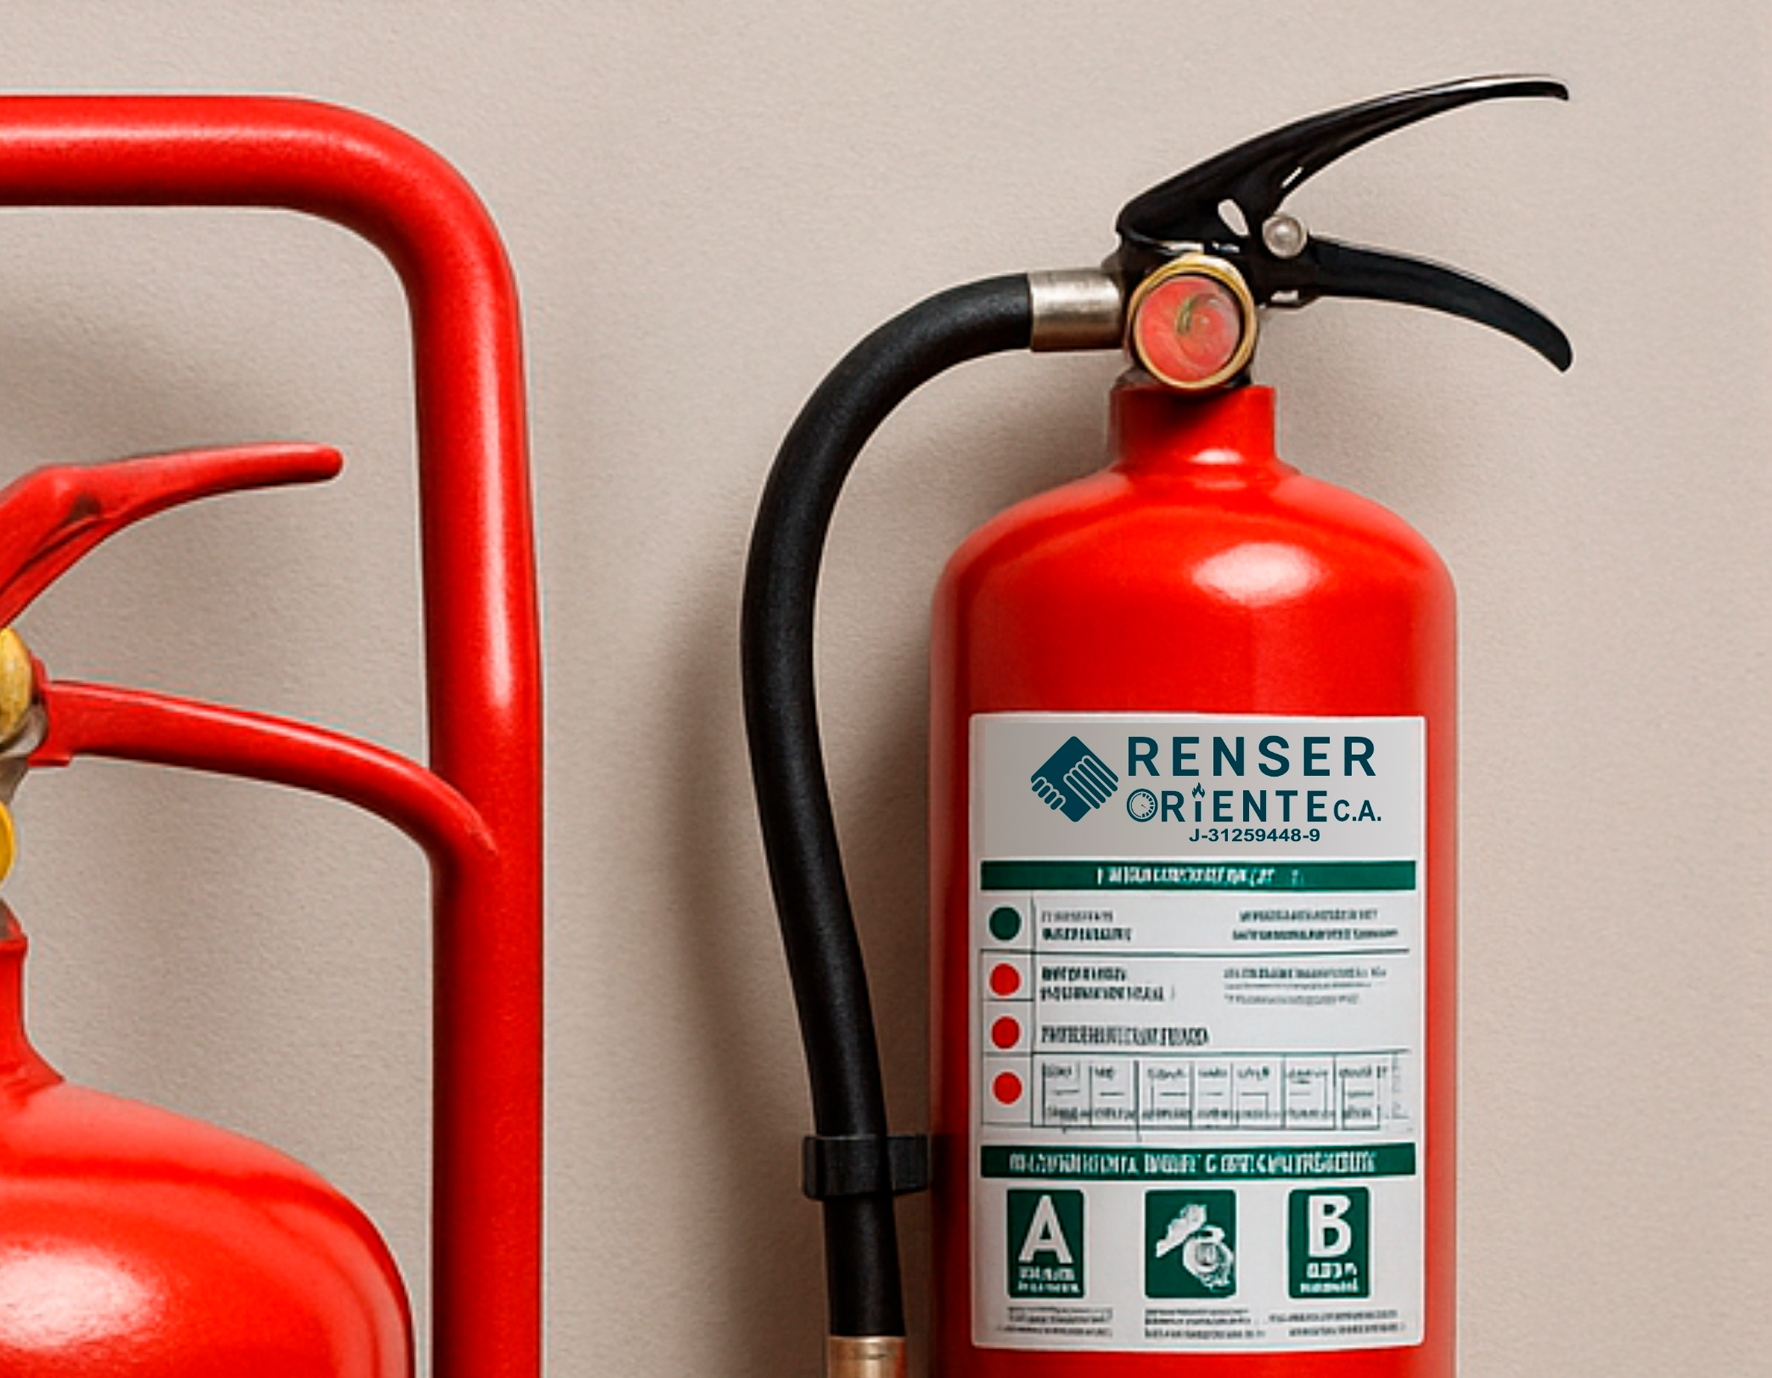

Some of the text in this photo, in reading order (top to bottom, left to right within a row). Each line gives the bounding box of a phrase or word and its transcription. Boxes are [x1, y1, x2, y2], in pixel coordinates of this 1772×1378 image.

[1128, 735, 1377, 778] RENSER
[1189, 828, 1321, 843] J-31259448-9
[1018, 1195, 1074, 1264] A
[1308, 1194, 1353, 1258] B
